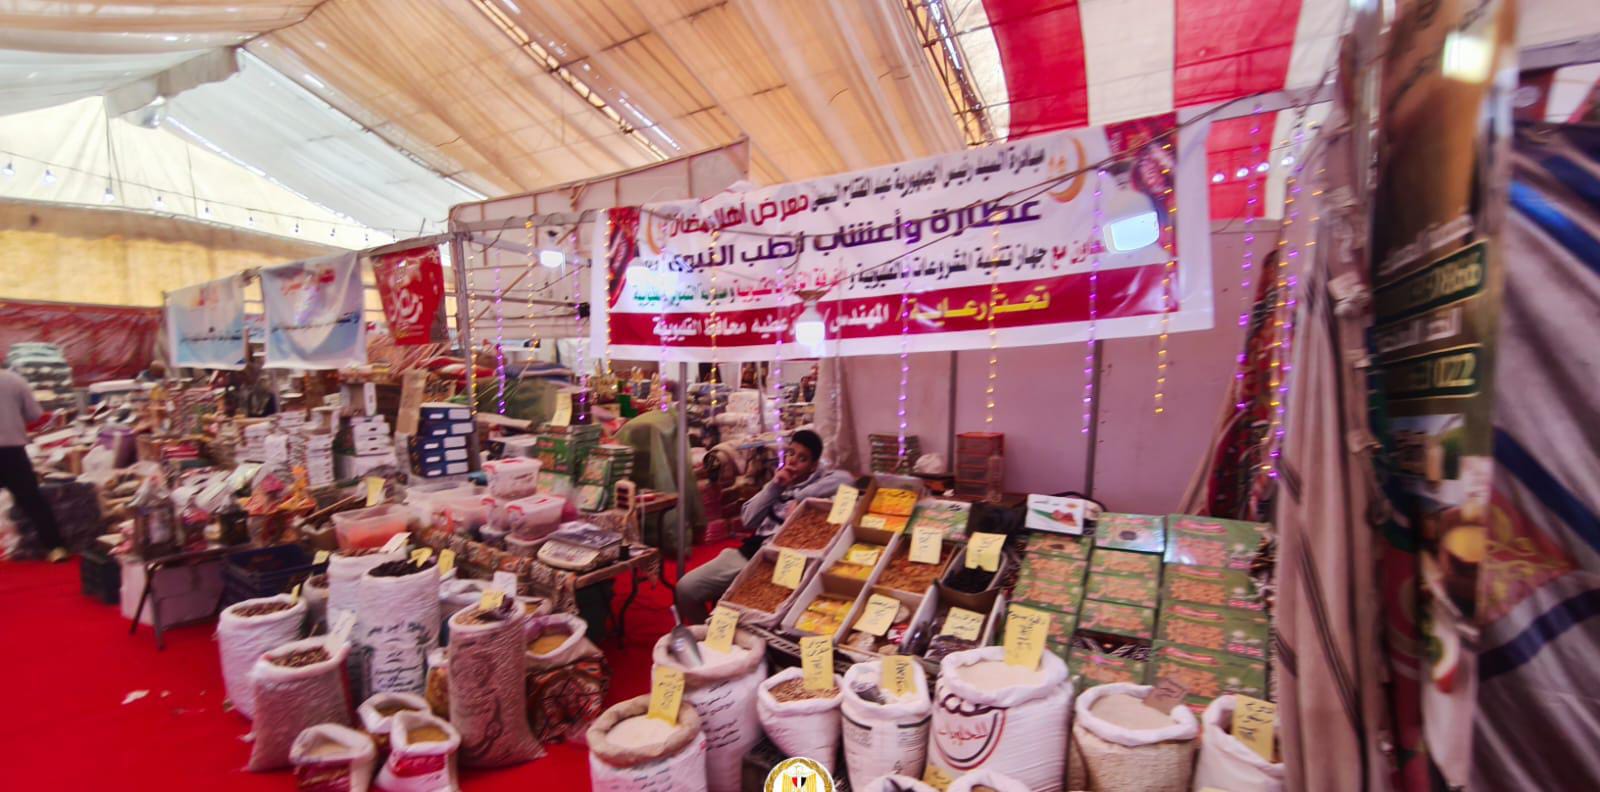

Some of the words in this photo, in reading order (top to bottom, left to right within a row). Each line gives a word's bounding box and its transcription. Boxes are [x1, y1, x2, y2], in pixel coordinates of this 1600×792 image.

[894, 162, 940, 198] الجمهورية
[974, 150, 1007, 181] السيد
[751, 193, 809, 227] معرض
[930, 199, 1042, 237] عطارة
[813, 208, 921, 257] وأعشاب
[740, 231, 805, 268] الطب
[912, 249, 974, 281] المشروعات
[1013, 244, 1047, 271] جهاز
[1051, 244, 1068, 270] مع
[991, 284, 1050, 314] تحت
